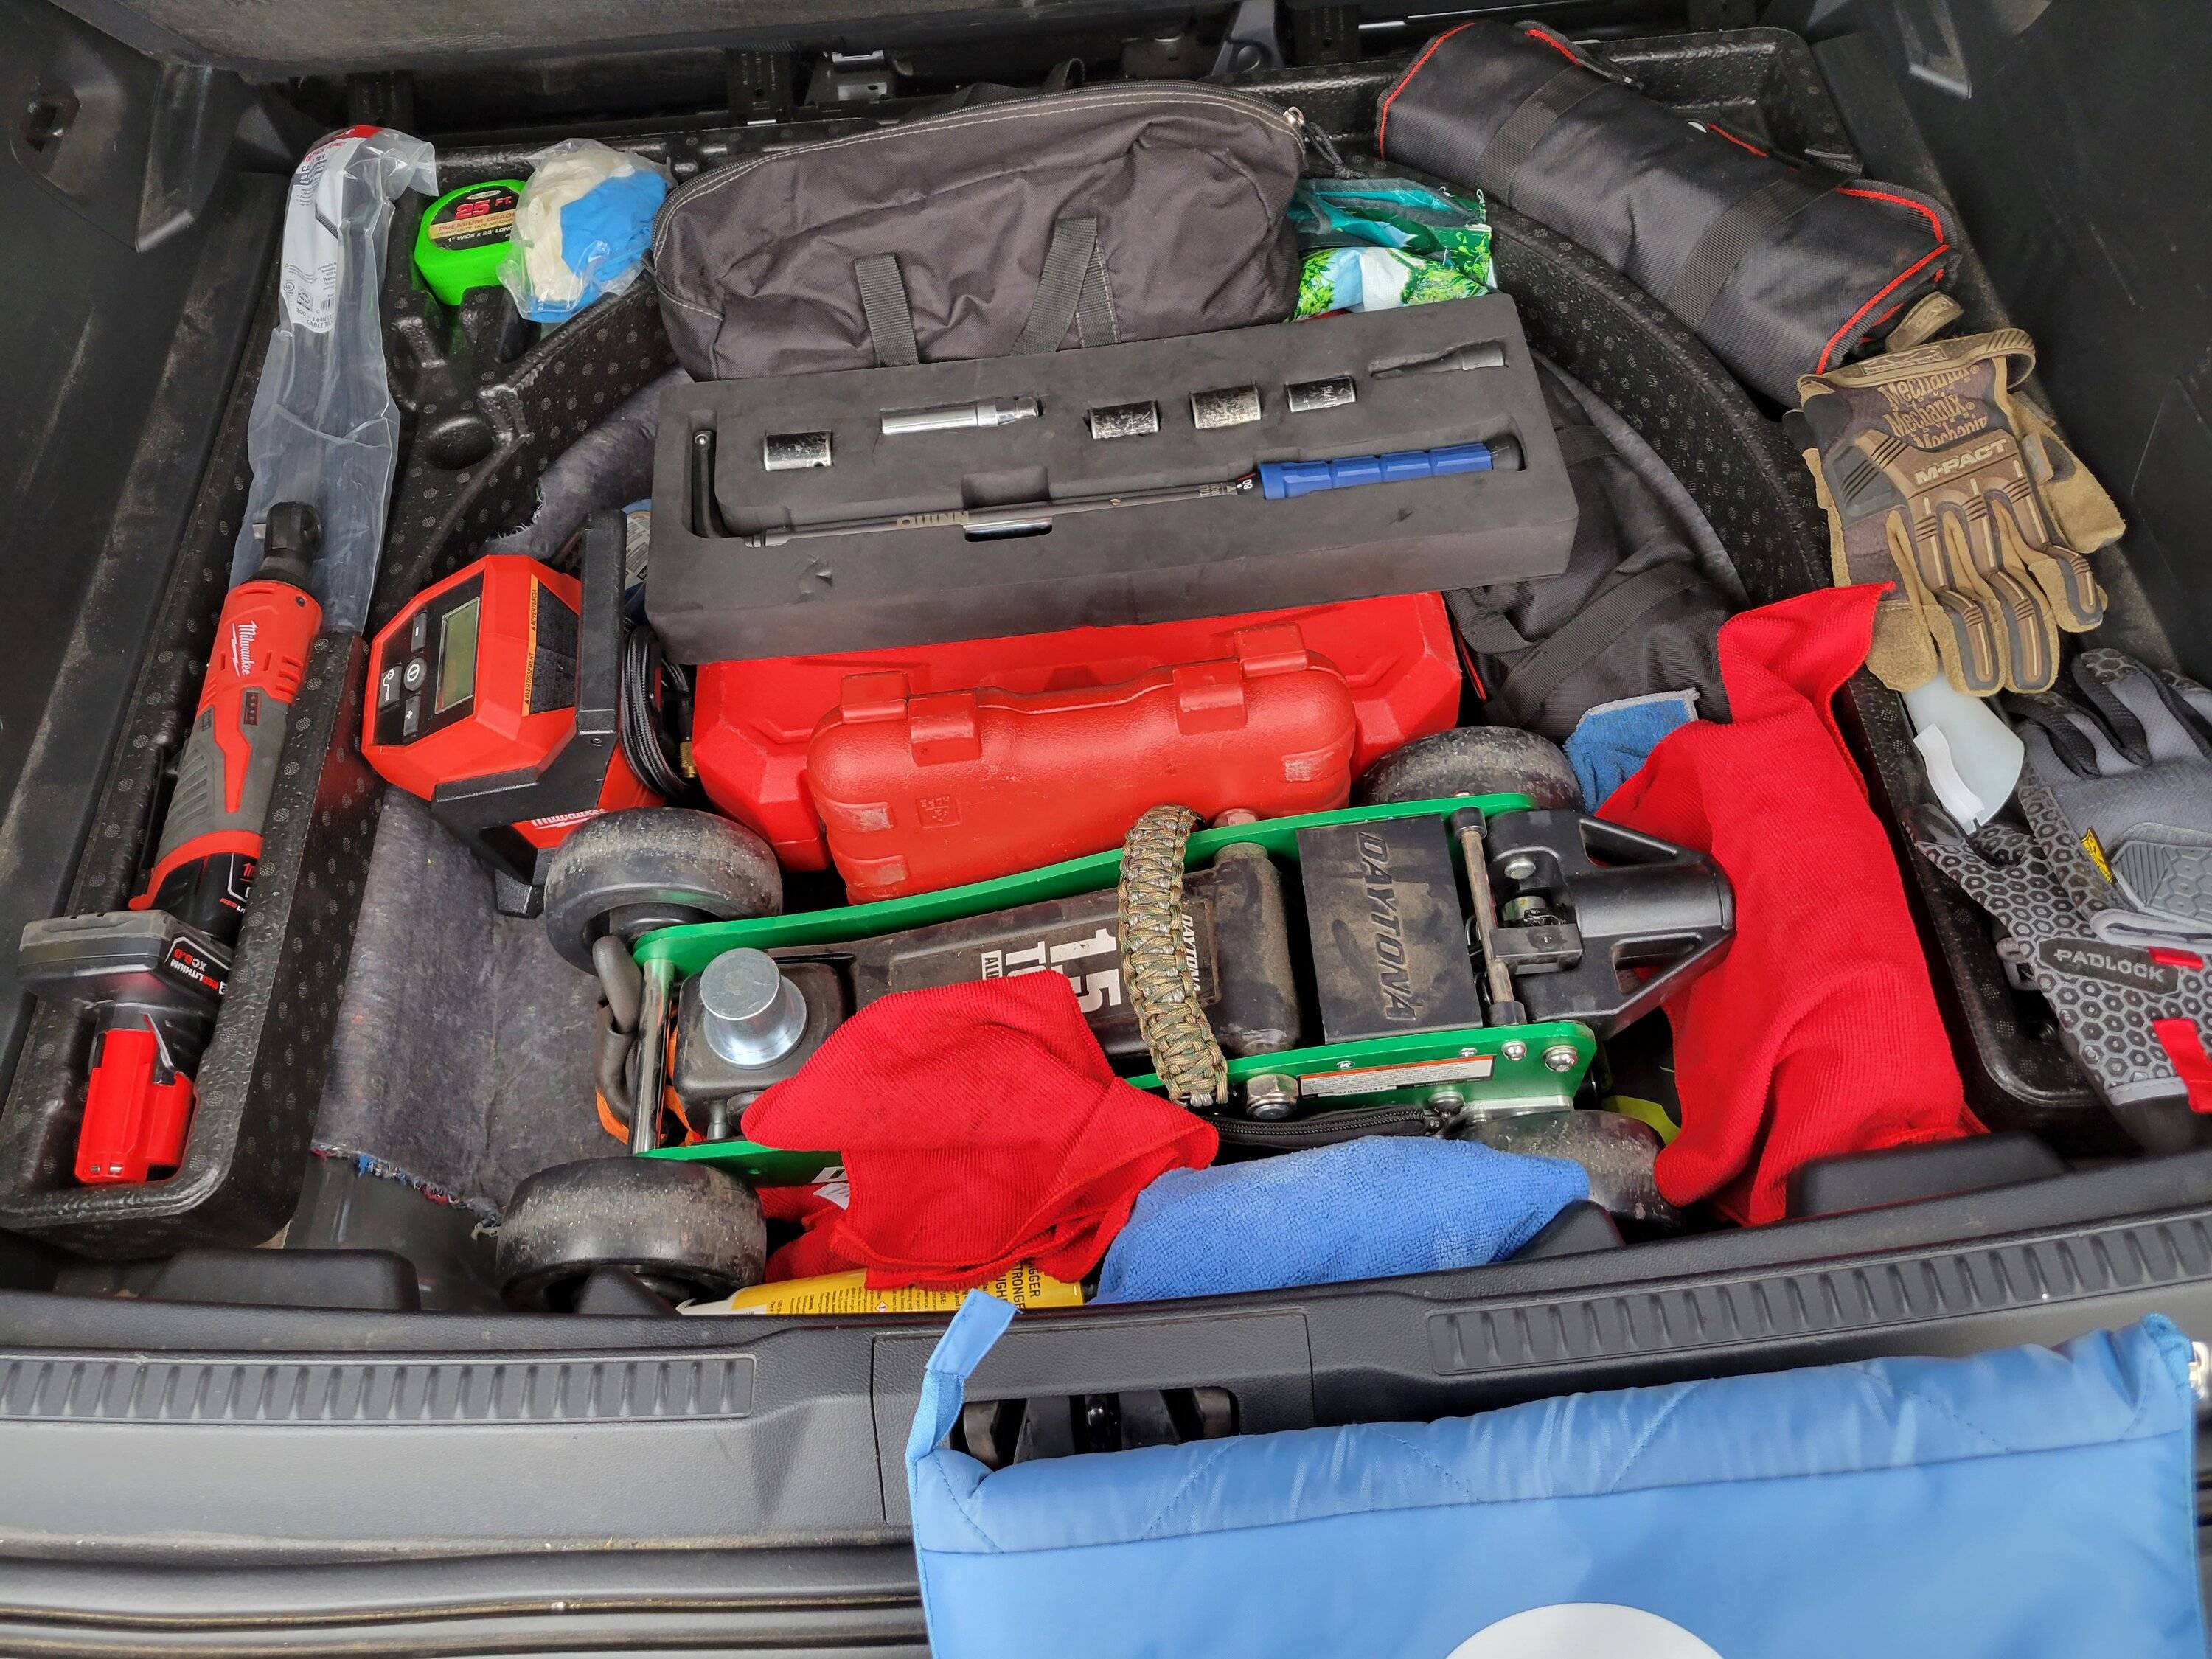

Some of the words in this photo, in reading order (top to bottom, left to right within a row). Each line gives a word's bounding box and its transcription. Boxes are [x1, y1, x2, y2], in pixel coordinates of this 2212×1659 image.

[454, 199, 490, 220] 25
[439, 219, 484, 232] PREMIUM
[457, 233, 476, 241] WIDE
[307, 319, 324, 329] CABLE
[1882, 393, 1968, 438] Mechanix
[896, 510, 969, 530] QUINN
[237, 619, 259, 676] Milwaukee
[524, 652, 535, 700] AVERTISSEMENT
[1357, 831, 1416, 1021] DAYTONA
[2053, 948, 2166, 983] PADLOCK
